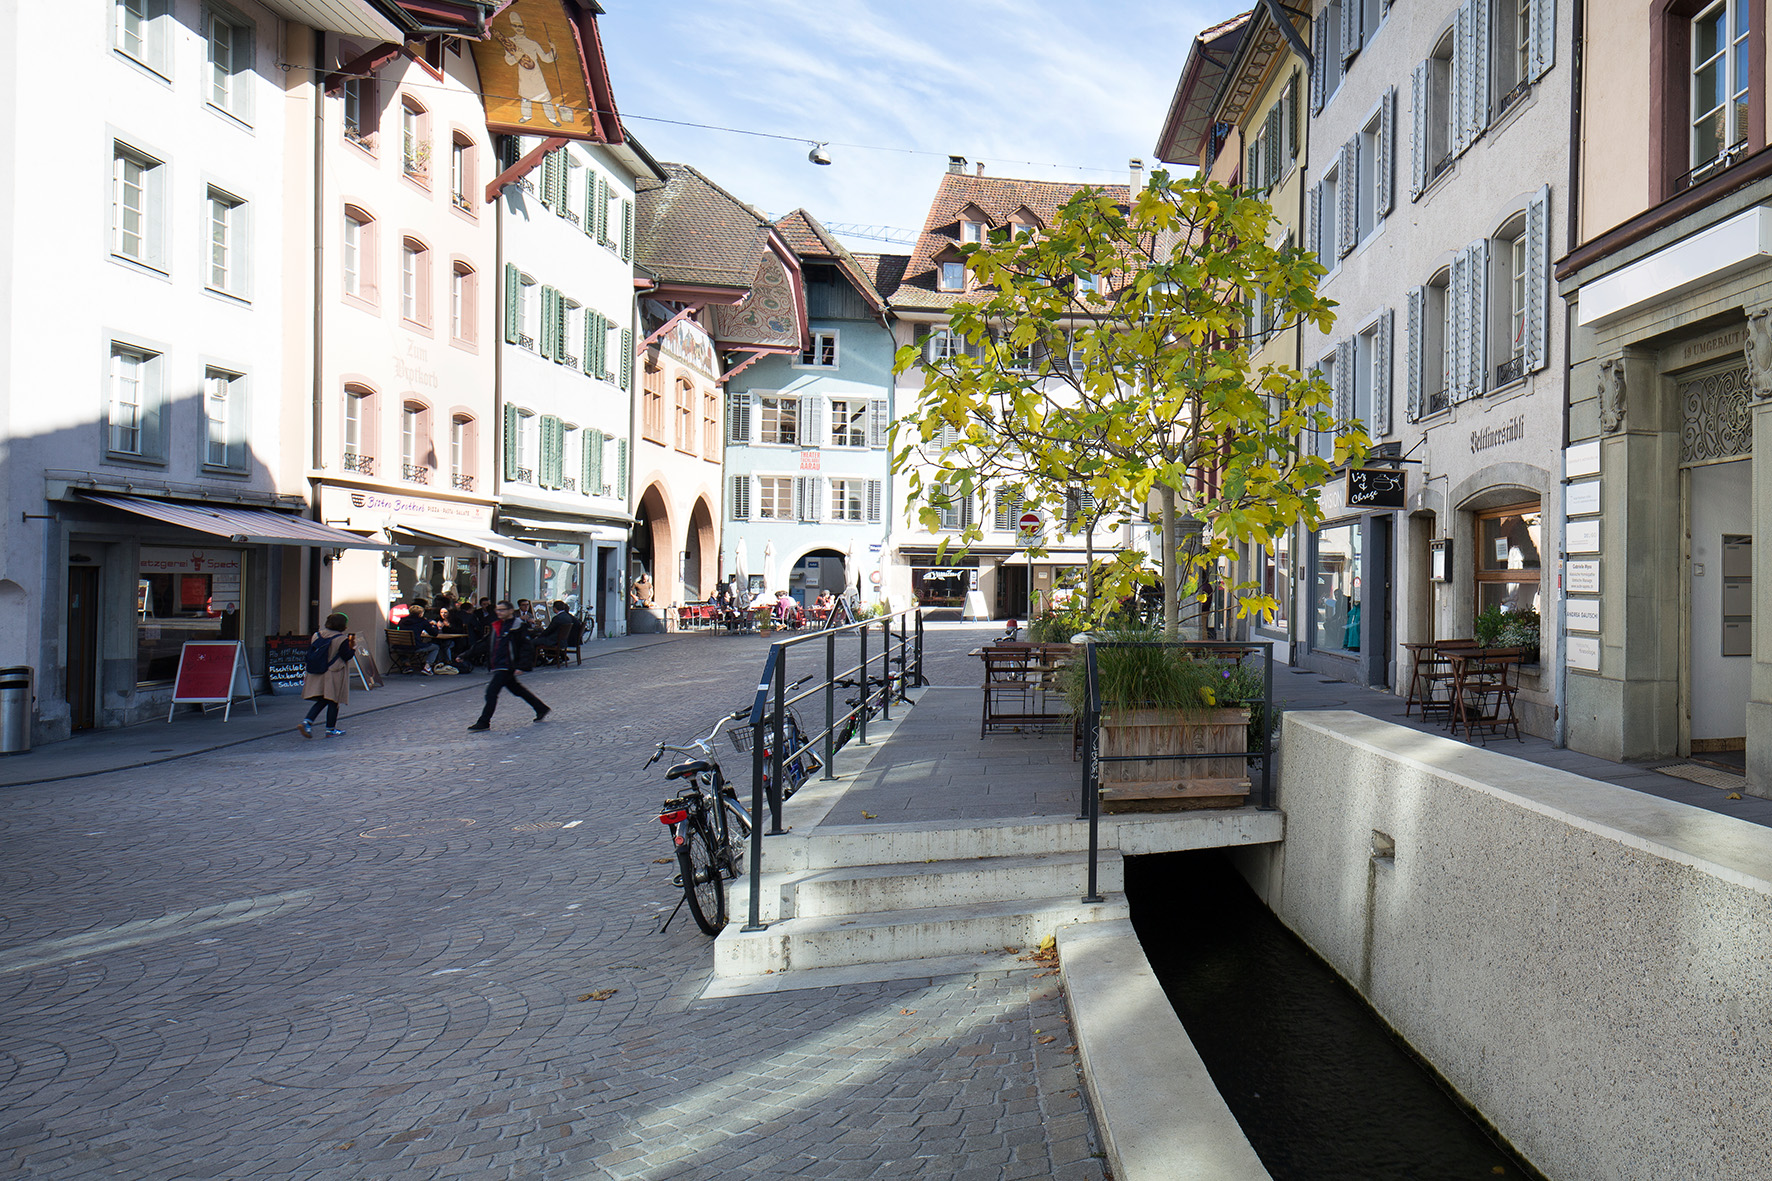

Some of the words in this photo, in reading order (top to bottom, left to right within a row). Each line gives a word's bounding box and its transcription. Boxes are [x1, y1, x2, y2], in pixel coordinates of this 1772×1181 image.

[1693, 331, 1740, 355] UMGEBAUT
[407, 337, 428, 362] Zum
[800, 462, 821, 470] AARAU
[367, 496, 392, 508] Bistro
[140, 560, 188, 569] etzgerei
[207, 559, 239, 569] Speck
[269, 671, 306, 680] Salzkartof
[278, 680, 305, 688] Salat
